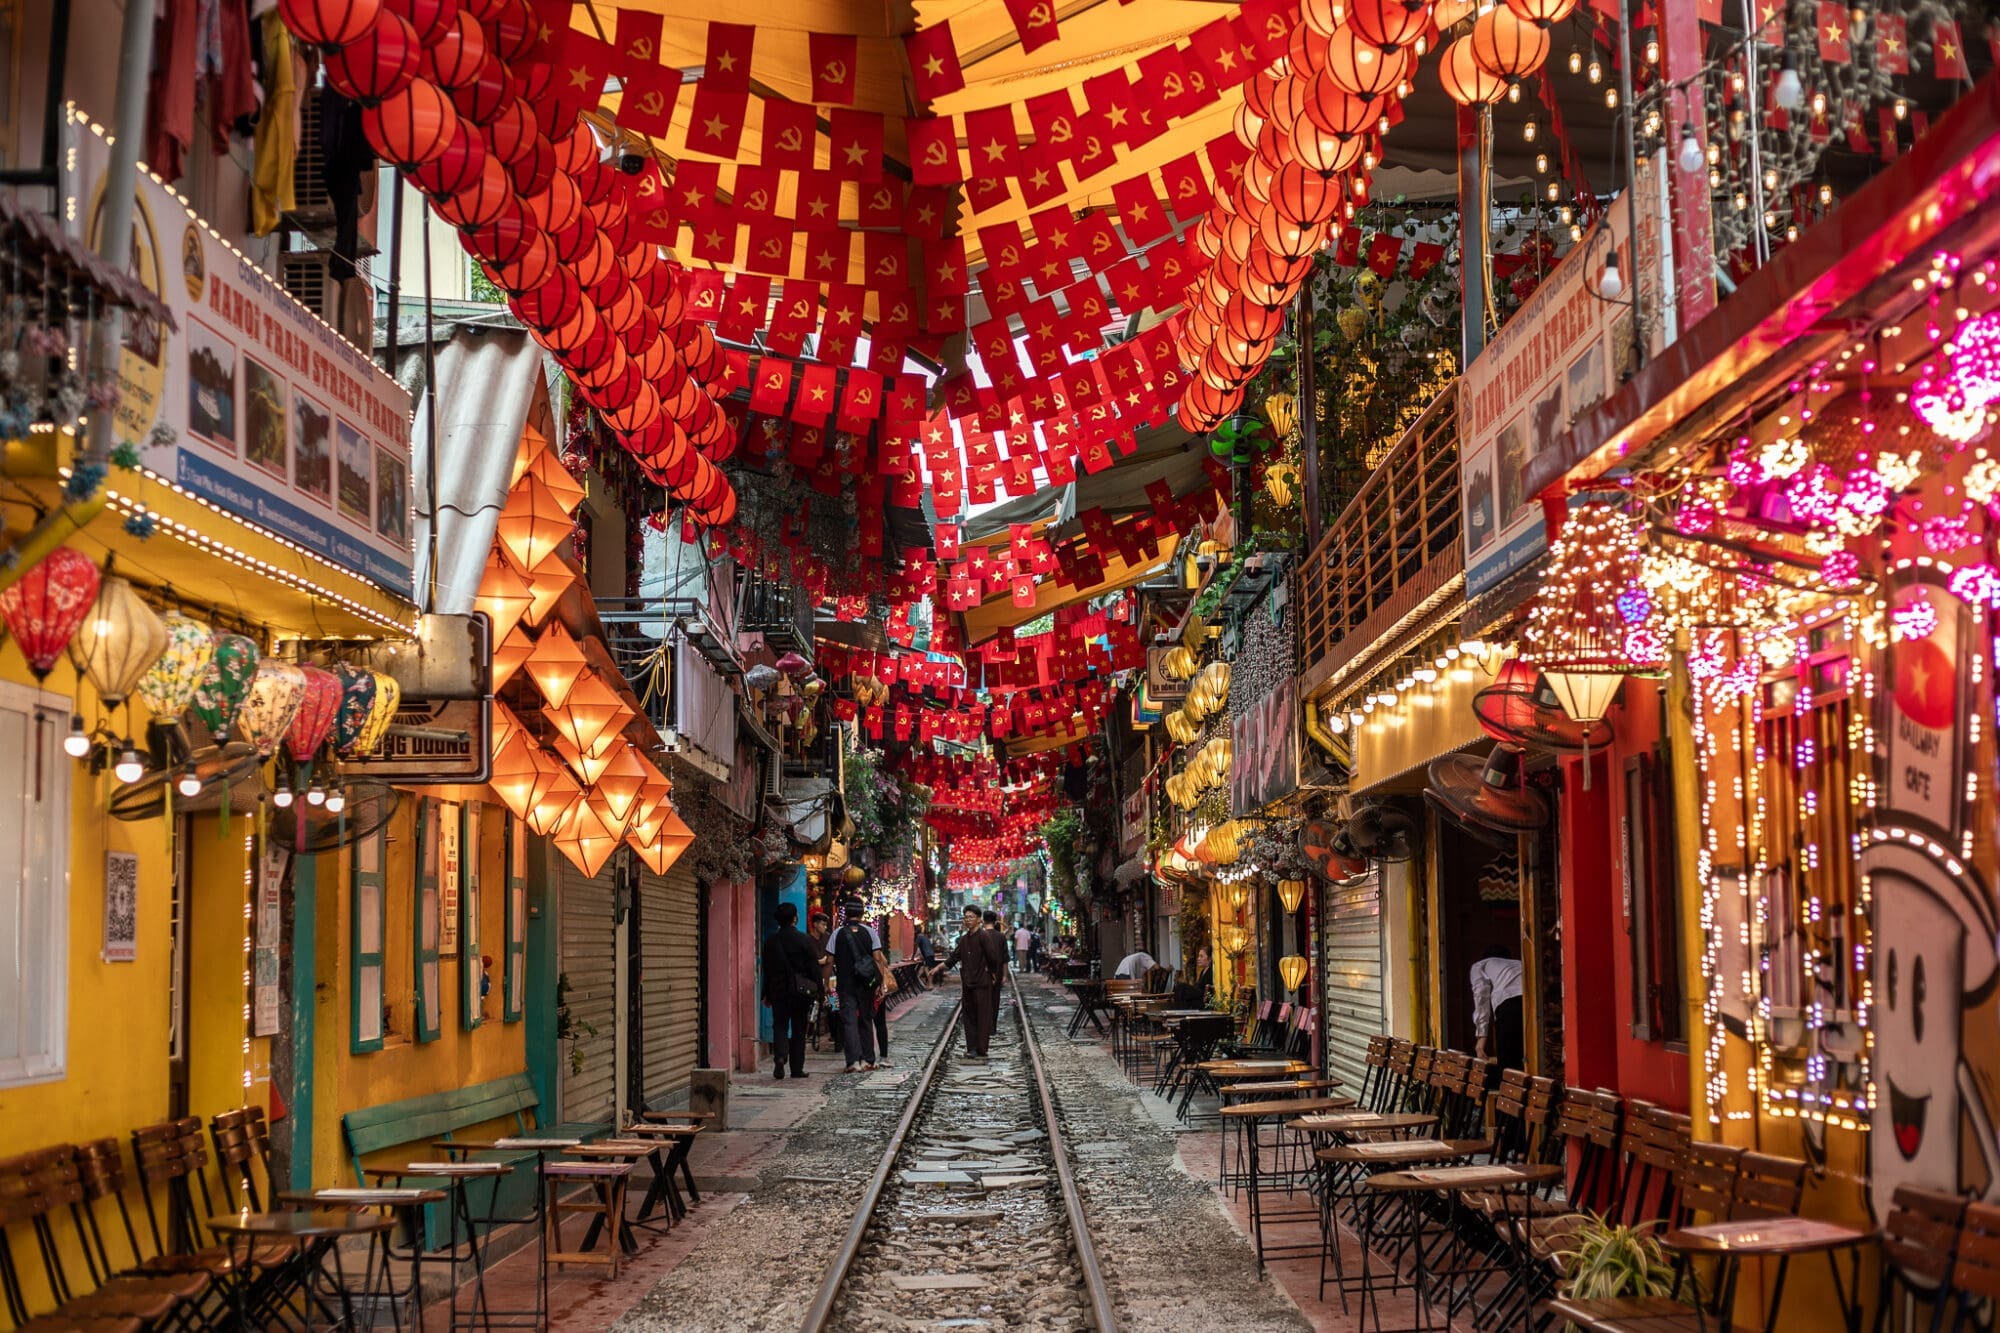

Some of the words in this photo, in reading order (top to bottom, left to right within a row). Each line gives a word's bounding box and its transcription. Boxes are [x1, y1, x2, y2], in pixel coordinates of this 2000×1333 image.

[1543, 276, 1593, 373] STREET
[312, 351, 362, 417] STREET
[364, 389, 411, 449] TRAVEL
